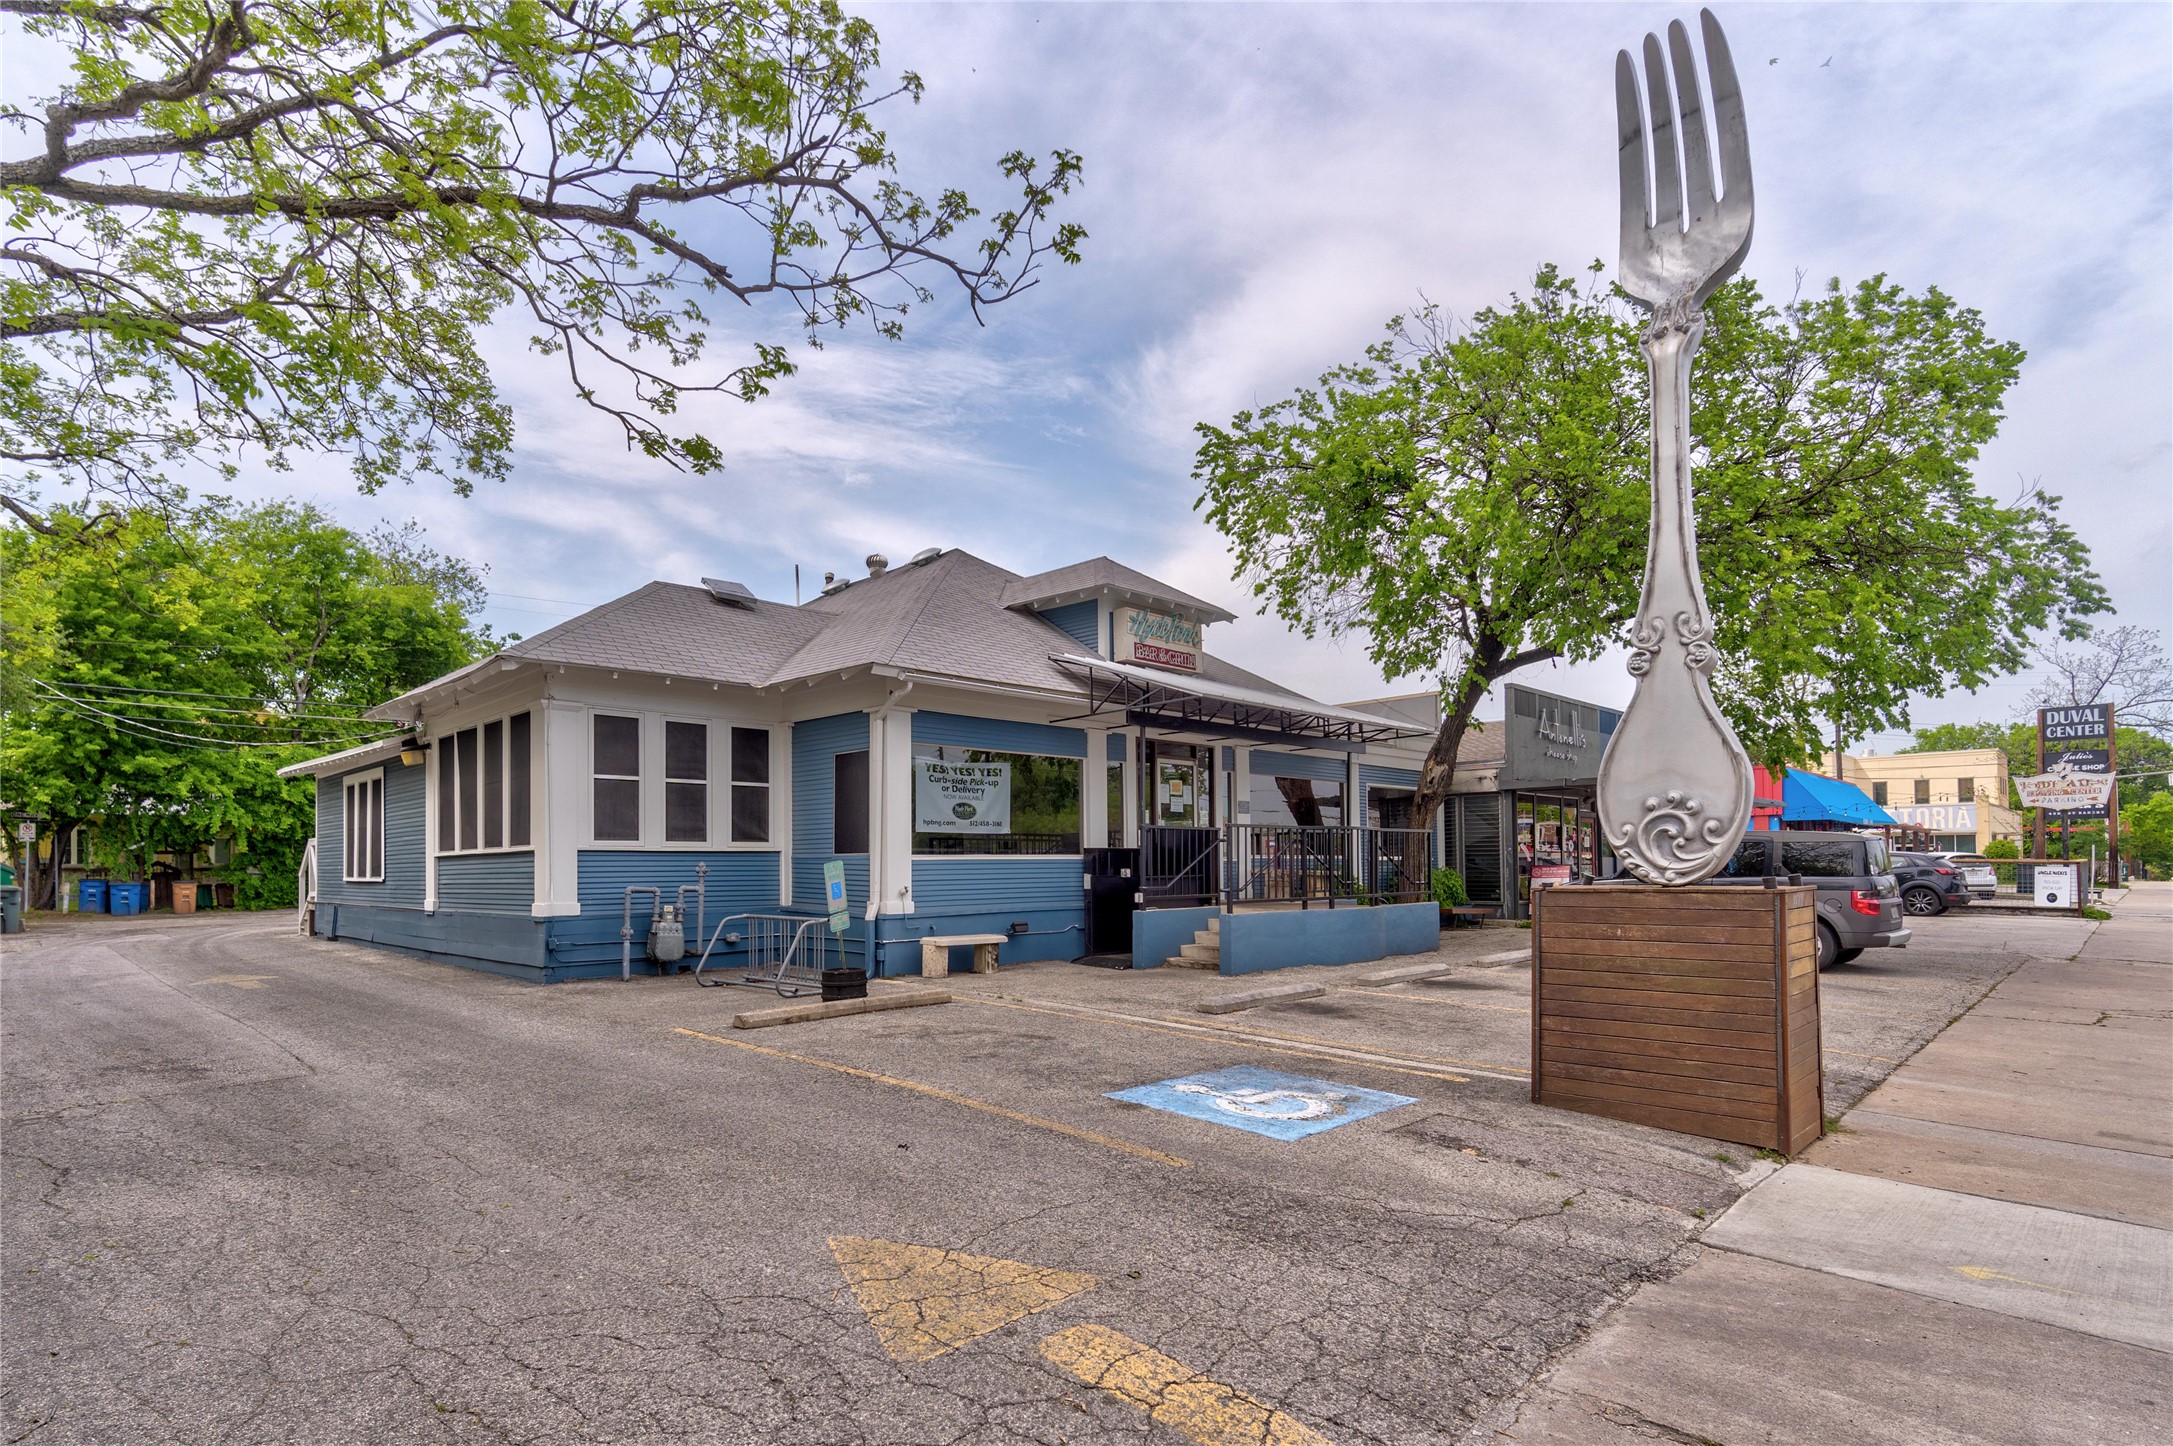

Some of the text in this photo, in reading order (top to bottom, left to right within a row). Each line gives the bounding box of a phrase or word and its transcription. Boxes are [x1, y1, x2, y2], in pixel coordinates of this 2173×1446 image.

[1128, 608, 1200, 647] Hyde Park
[1135, 643, 1196, 668] BAR & GRILL
[2046, 708, 2105, 725] DUVAL
[2046, 723, 2105, 738] CENTER
[2058, 751, 2093, 763] Julie's
[925, 763, 1003, 777] YES! YES! YES!
[2082, 763, 2105, 772] SHOP
[928, 774, 999, 788] Curb-side Pick-up
[952, 785, 986, 796] Delivery
[2041, 796, 2085, 804] PARKING
[922, 818, 956, 827] hpbng.com
[1884, 806, 1972, 829] TORIA
